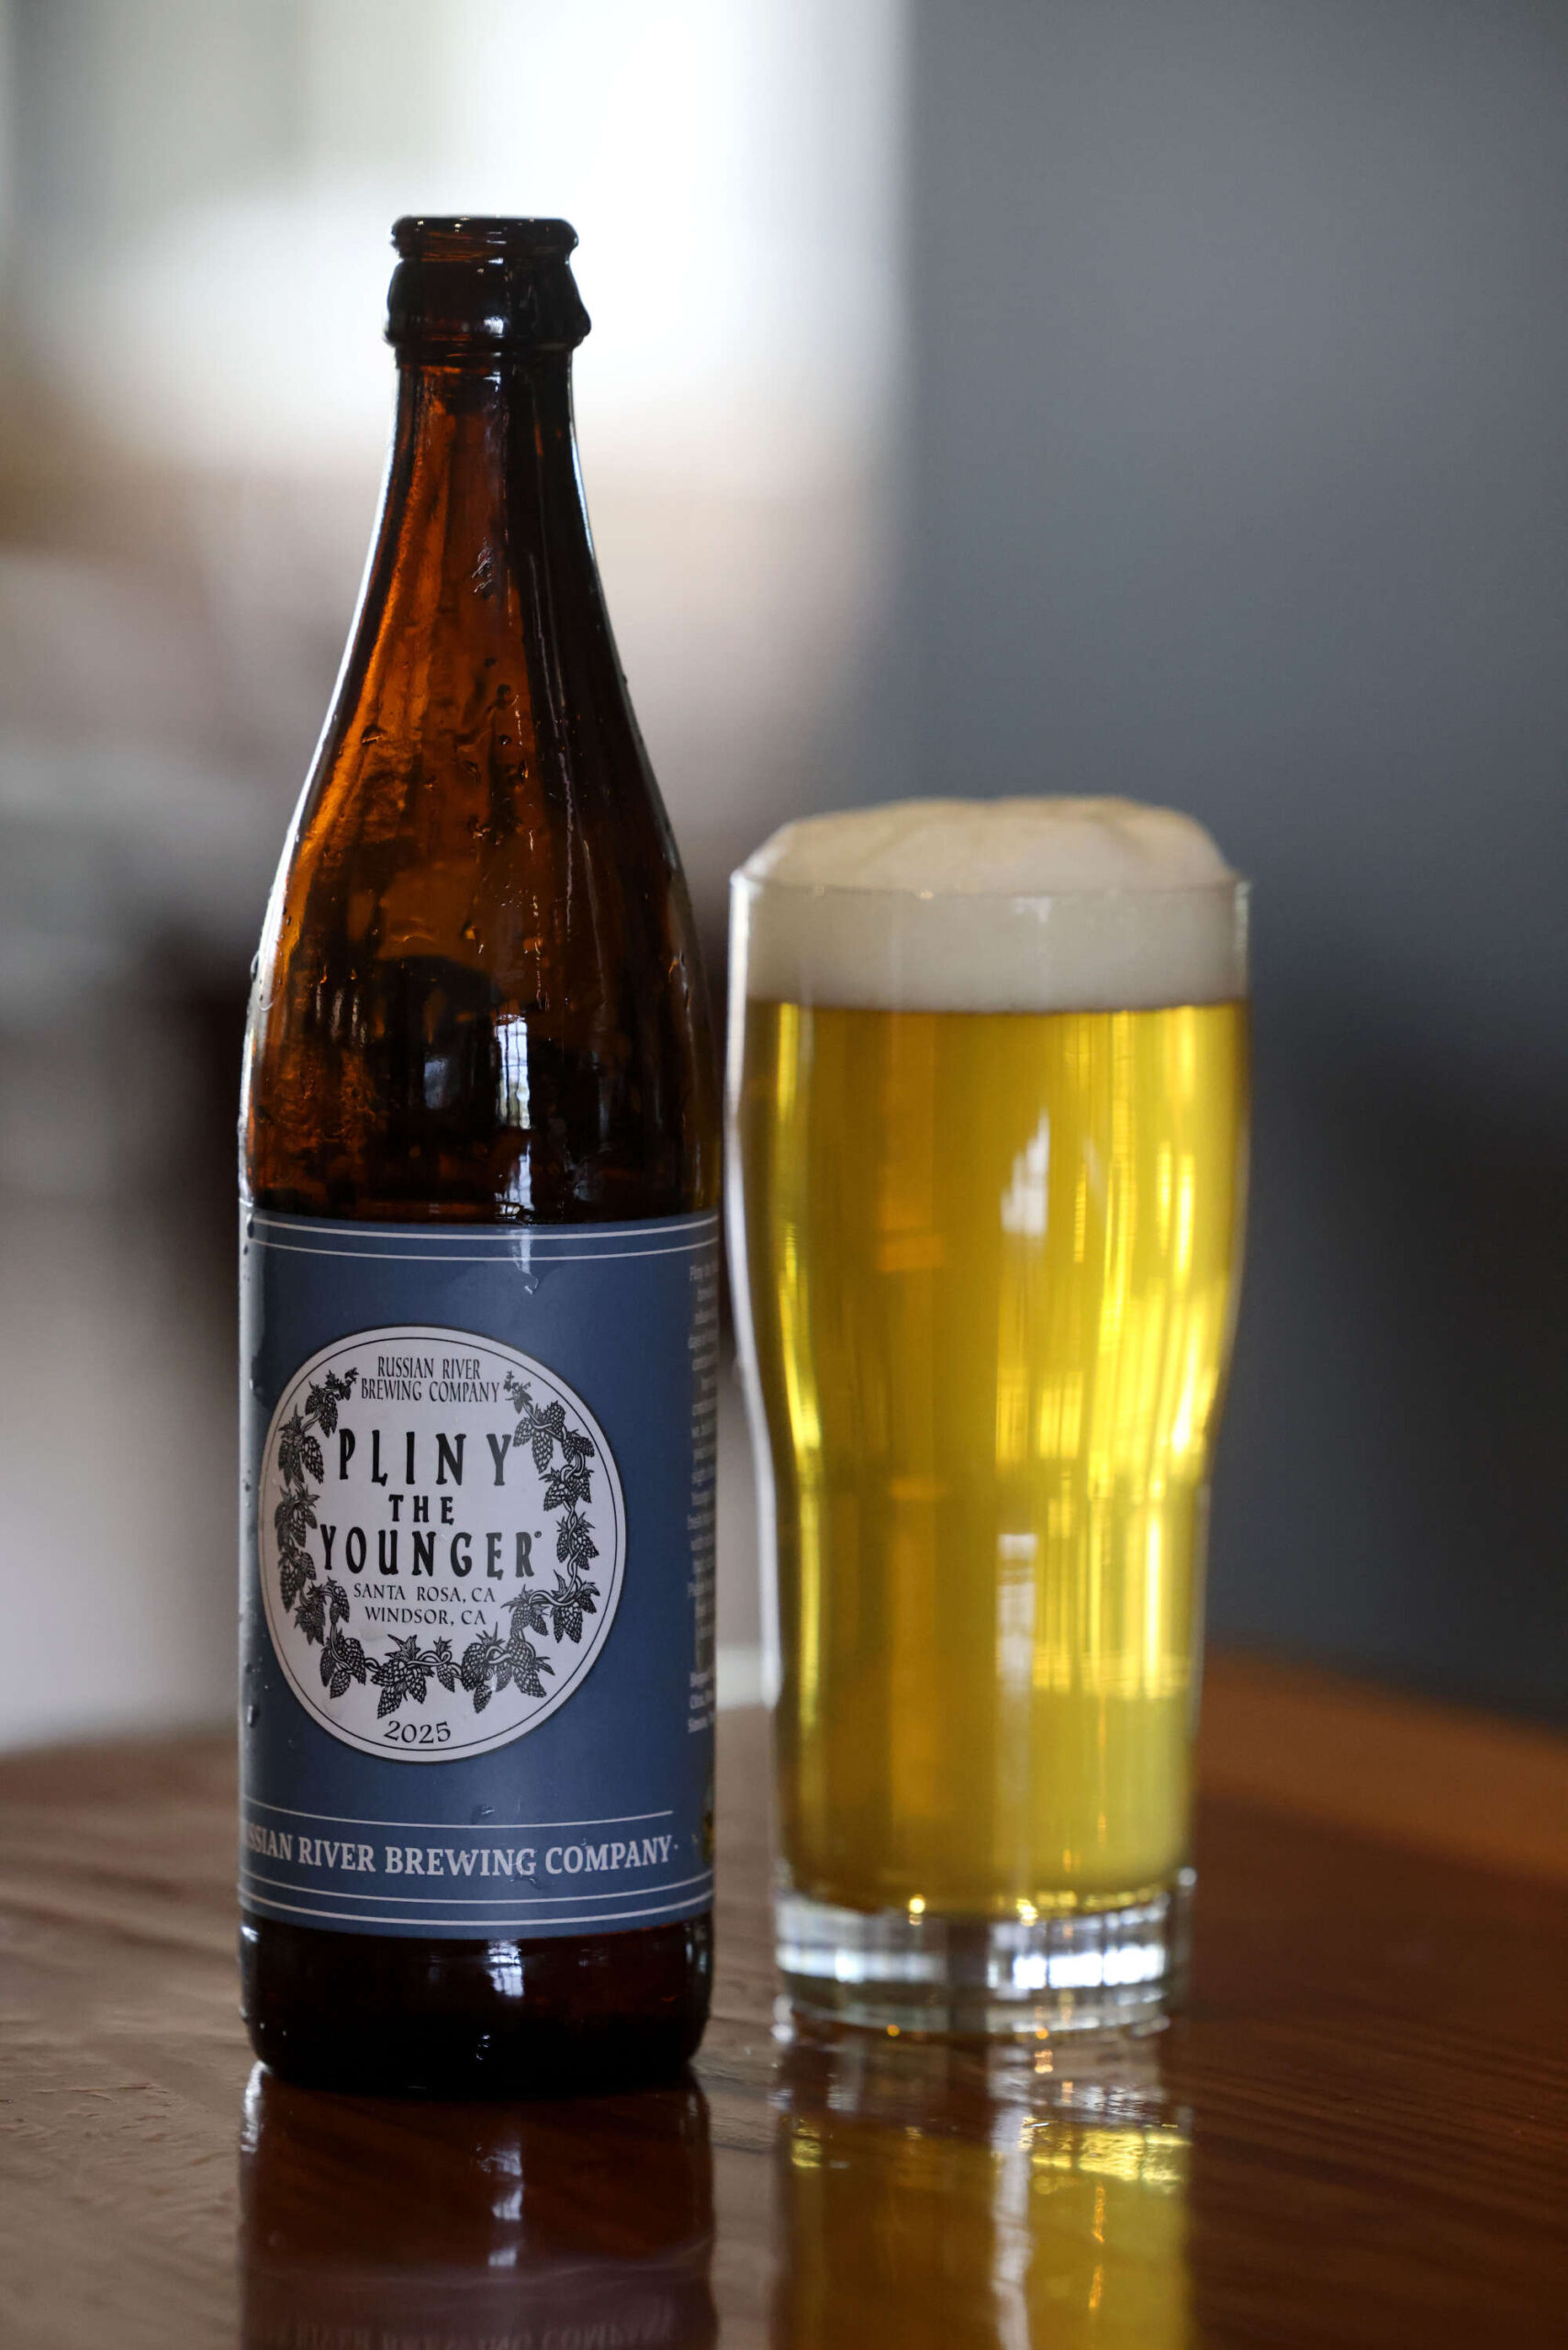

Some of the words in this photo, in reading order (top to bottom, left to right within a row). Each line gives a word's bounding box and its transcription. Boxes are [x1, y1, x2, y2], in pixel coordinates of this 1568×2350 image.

[377, 1356, 434, 1379] RUSSIAN
[442, 1358, 481, 1380] RIVER
[361, 1378, 422, 1402] BREWING
[429, 1381, 500, 1403] COMPANY
[339, 1427, 512, 1486] PLINY
[388, 1494, 454, 1525] THE
[353, 1583, 406, 1601] SANTA
[417, 1586, 466, 1604] ROSA,
[471, 1587, 496, 1603] CA
[364, 1606, 454, 1627] WINDSOR,
[461, 1610, 487, 1626] CA
[383, 1719, 452, 1744] 2025
[297, 1836, 377, 1873] RIVER
[385, 1845, 538, 1876] BREWING
